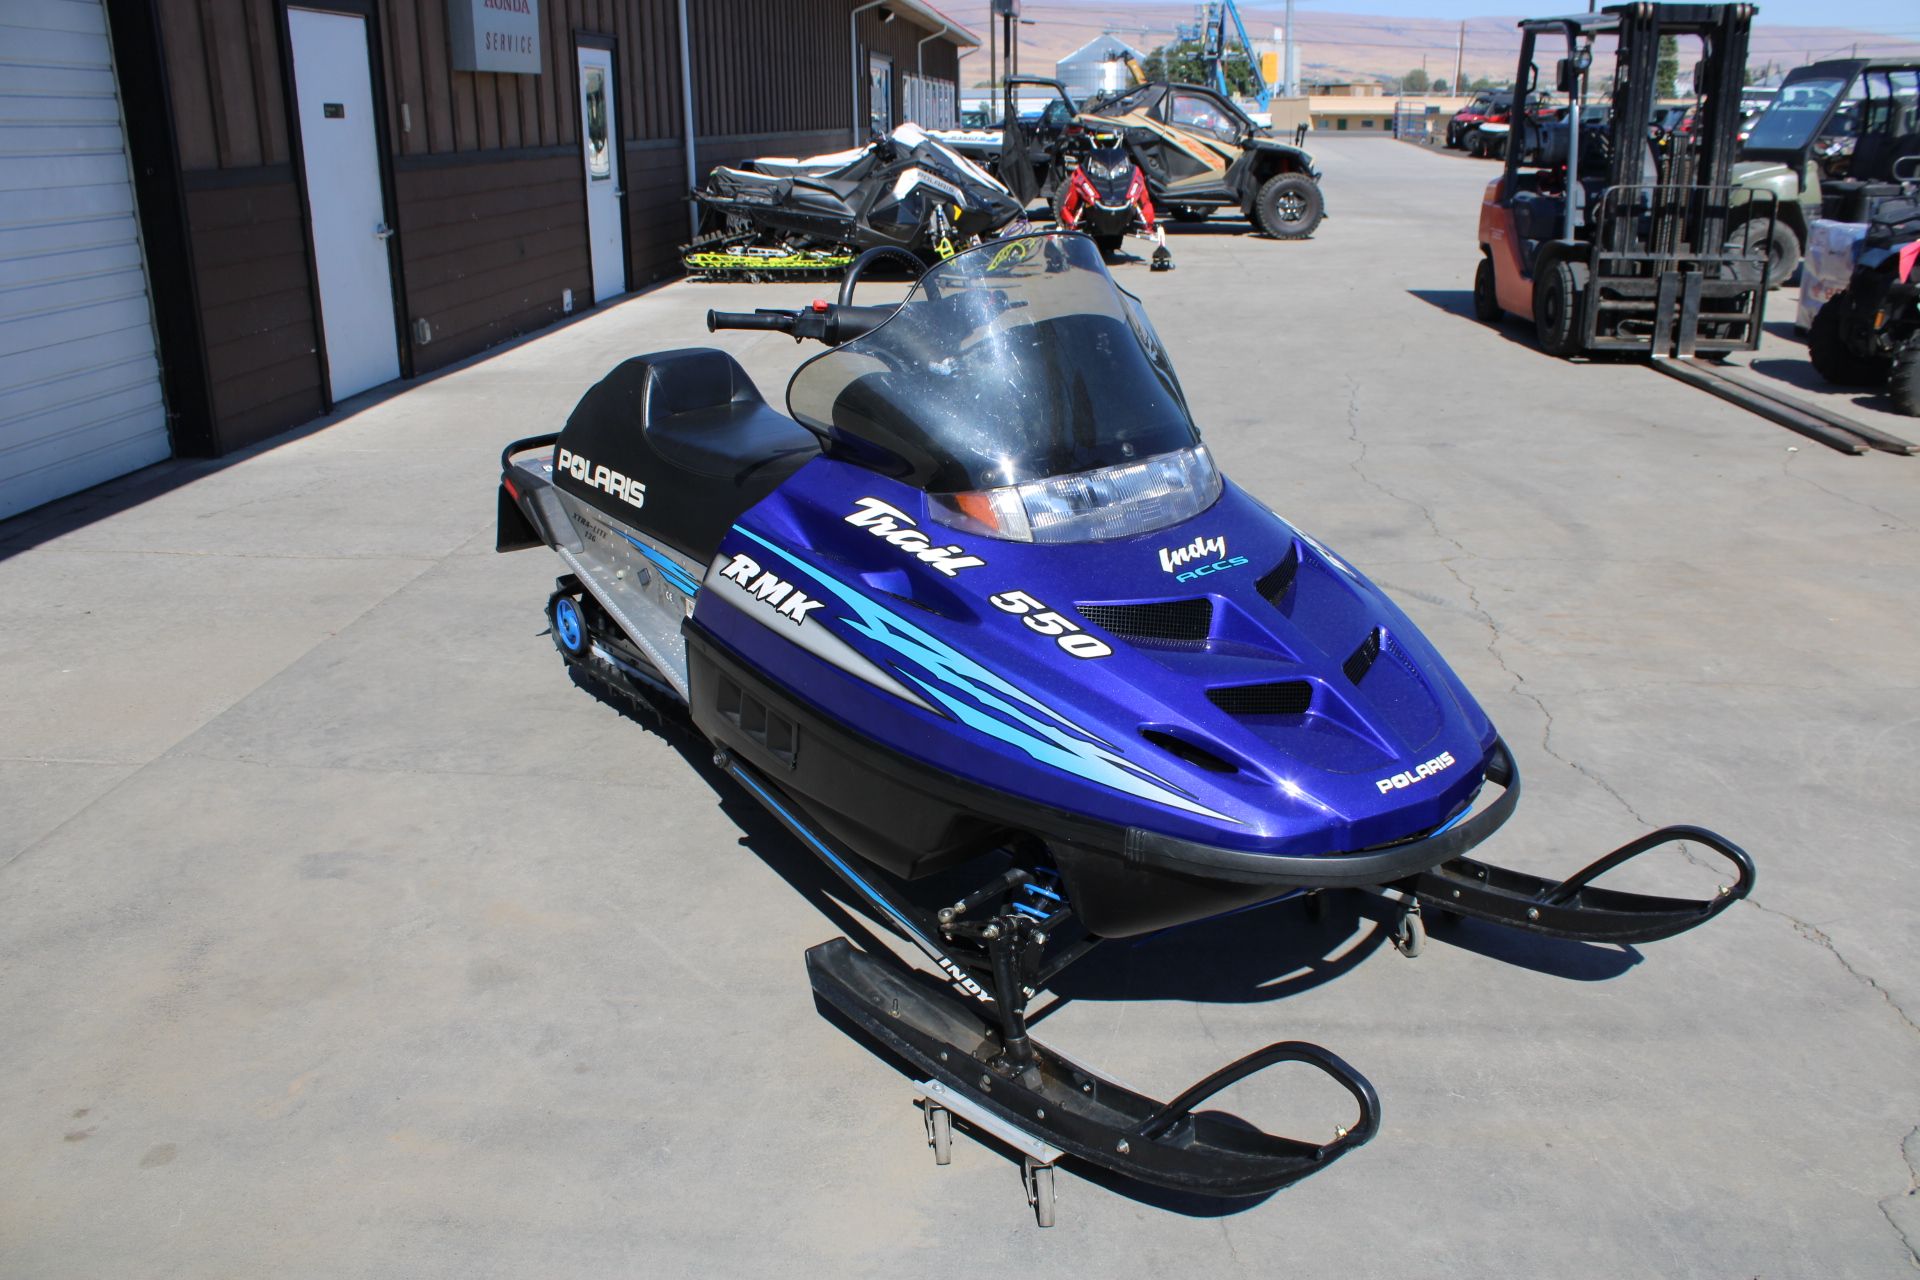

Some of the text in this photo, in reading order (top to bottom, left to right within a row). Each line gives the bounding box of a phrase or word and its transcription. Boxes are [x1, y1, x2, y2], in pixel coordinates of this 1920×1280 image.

[485, 31, 532, 54] SERVICE
[557, 447, 646, 509] POLARIS
[844, 497, 986, 577] Trail
[1158, 535, 1226, 573] Indy
[719, 553, 826, 627] RMK
[1175, 555, 1249, 583] ACCS
[988, 590, 1113, 659] 550
[1375, 750, 1456, 794] POLARIS
[938, 957, 996, 1002] INDY
